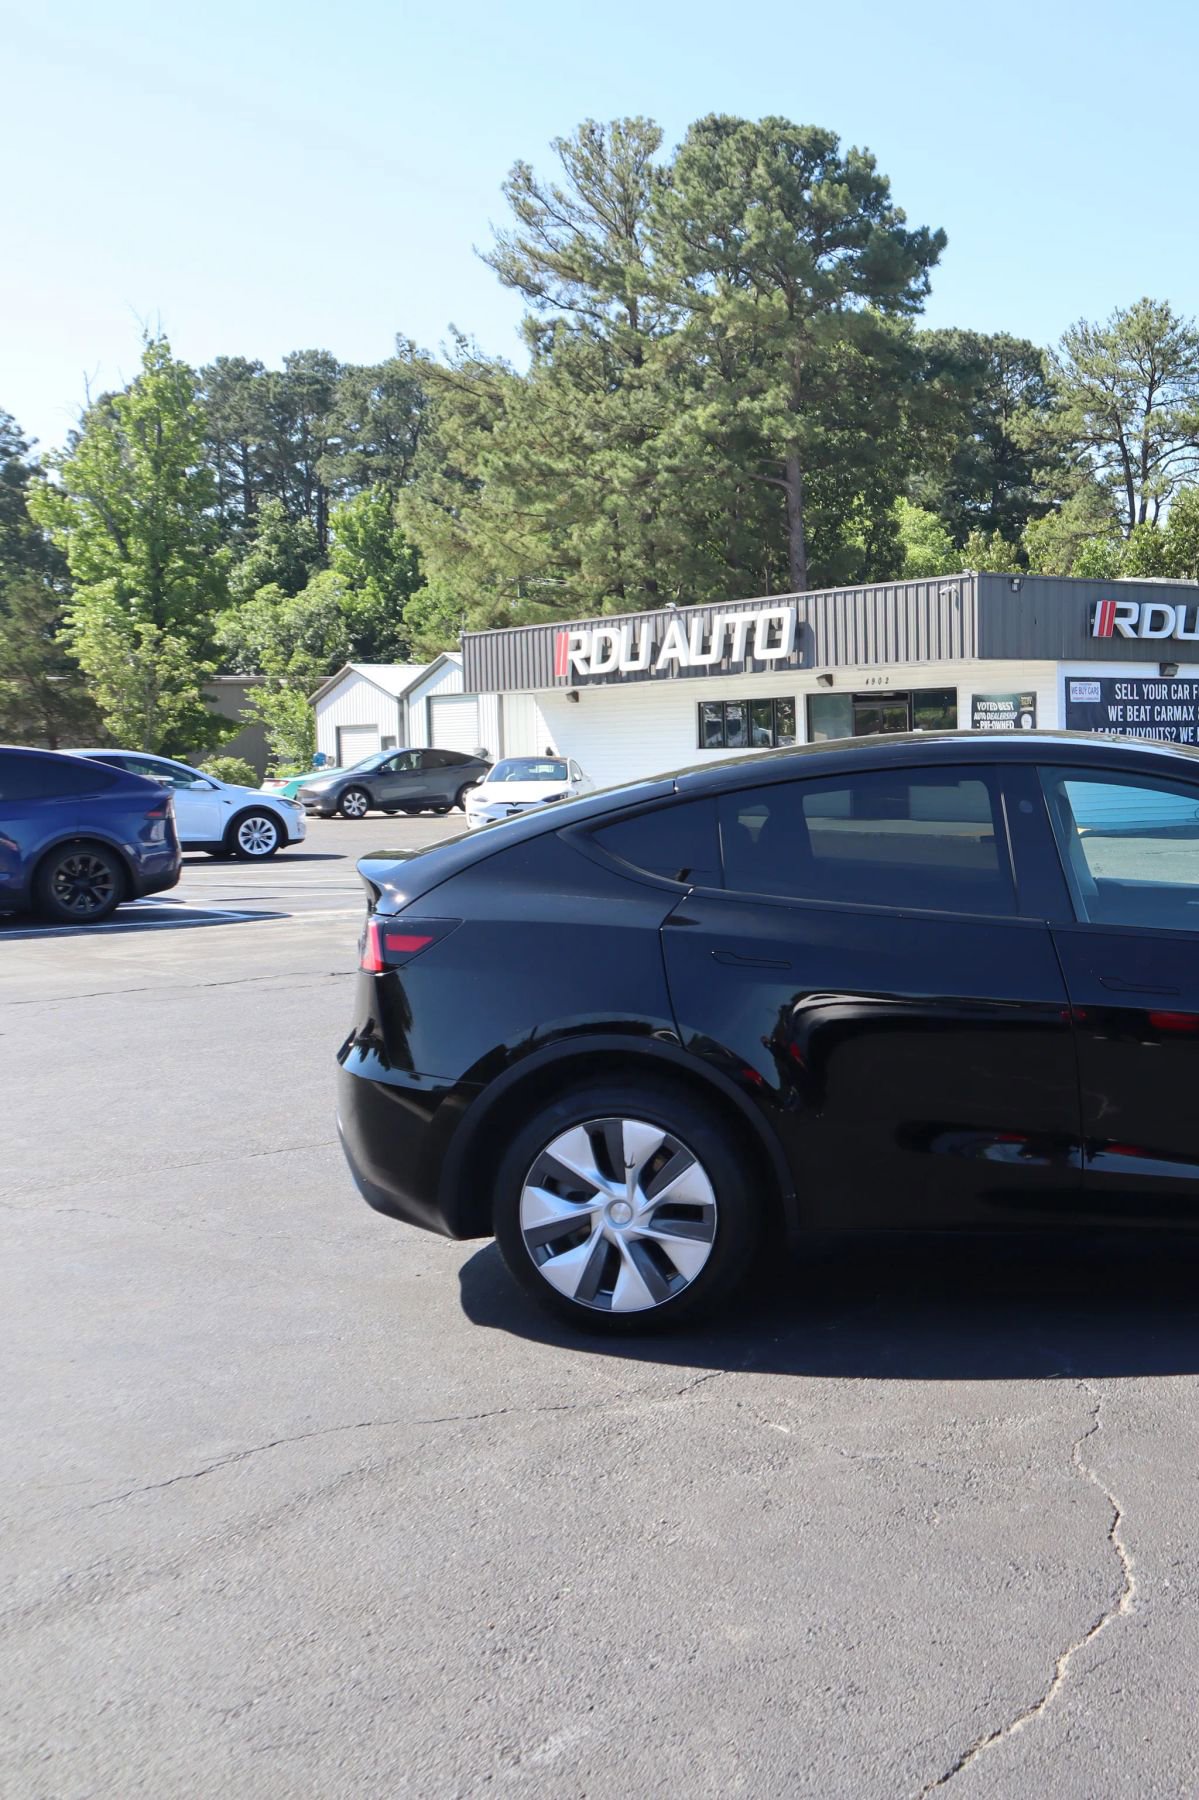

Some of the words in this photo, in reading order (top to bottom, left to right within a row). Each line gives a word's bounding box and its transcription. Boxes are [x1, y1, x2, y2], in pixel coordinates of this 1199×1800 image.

[554, 622, 650, 677] RDU
[656, 607, 796, 671] AUTO
[865, 676, 889, 686] 4902
[1115, 683, 1139, 700] SELL
[1142, 684, 1168, 700] YOUR
[1171, 684, 1190, 700] CAR
[976, 701, 997, 711] VOTED
[997, 701, 1014, 711] BEST
[1108, 705, 1123, 722] WE
[1126, 705, 1151, 721] BEAT
[1154, 705, 1195, 722] CARMAX
[1179, 726, 1195, 743] WE
